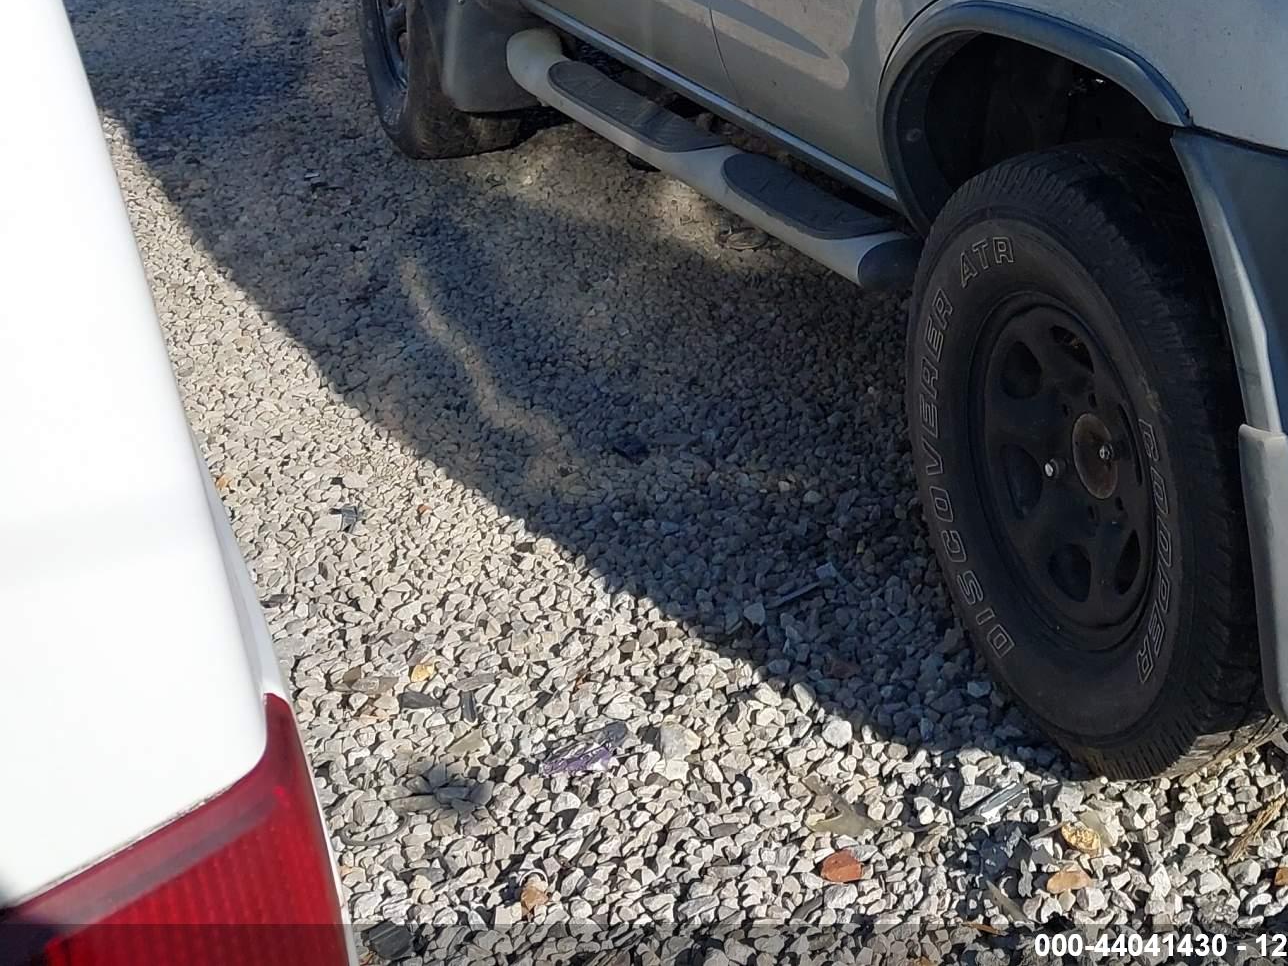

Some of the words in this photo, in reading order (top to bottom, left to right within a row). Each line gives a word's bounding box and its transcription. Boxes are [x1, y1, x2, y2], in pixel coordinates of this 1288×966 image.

[959, 235, 1016, 289] ATR
[918, 287, 1016, 659] DISCOVERER
[1136, 417, 1174, 685] COOPER
